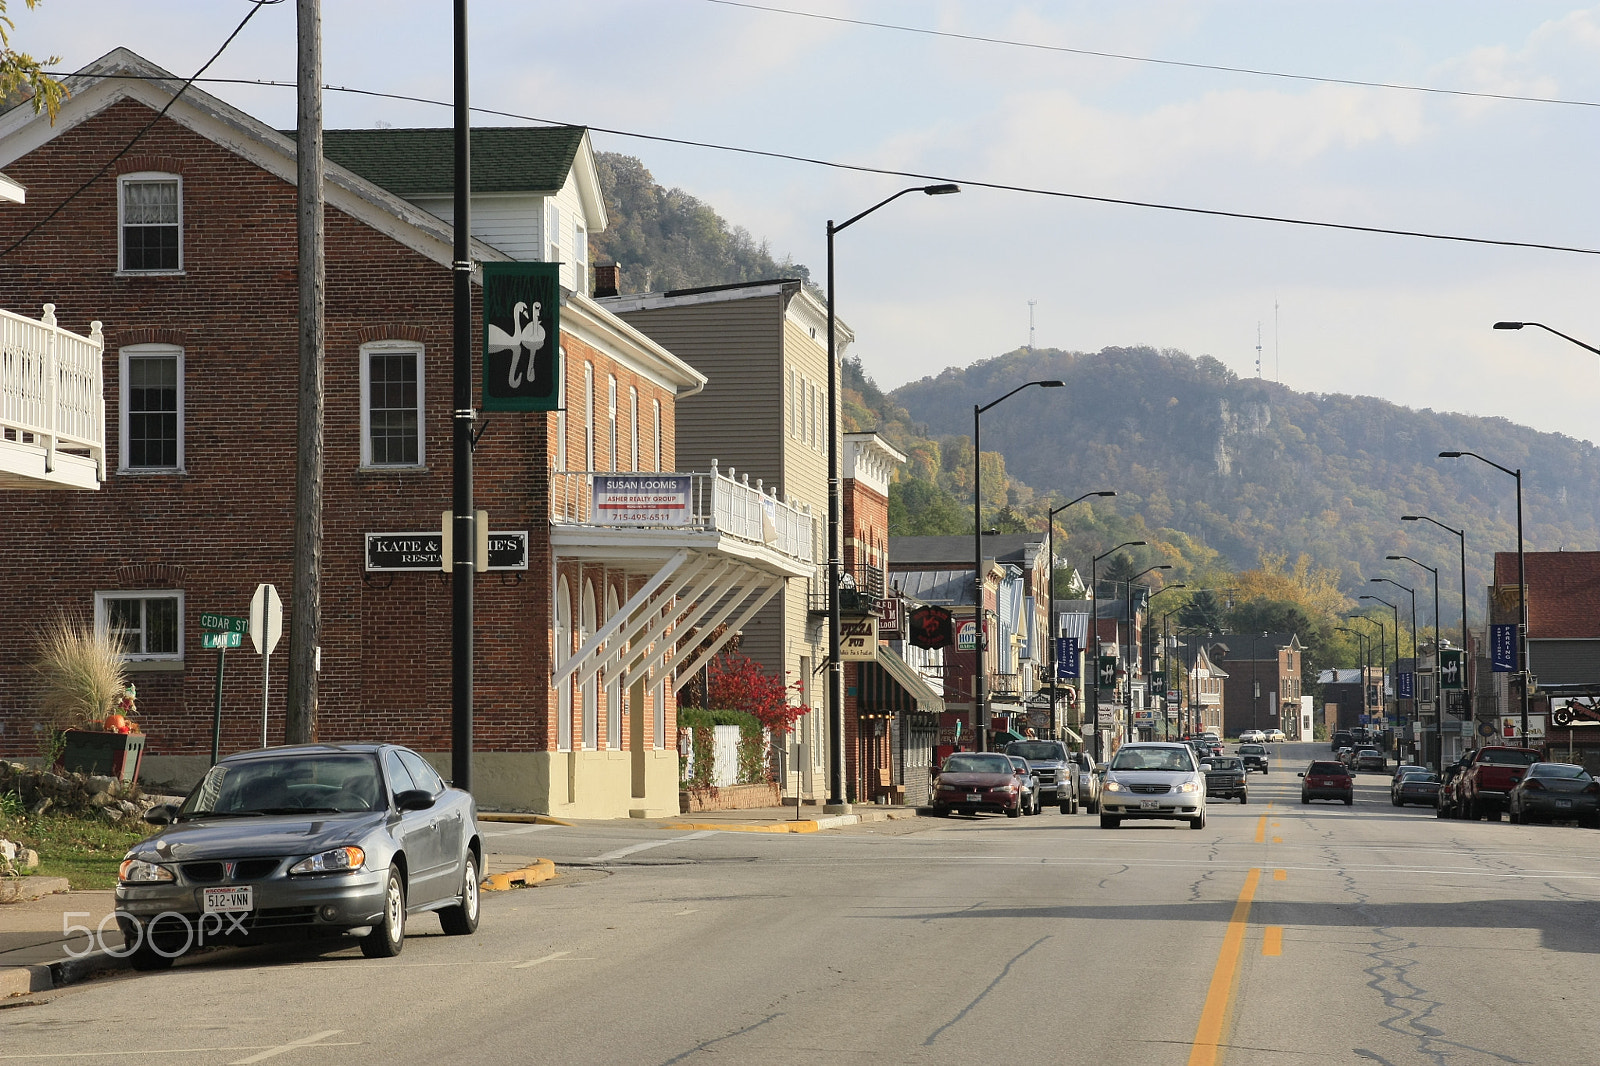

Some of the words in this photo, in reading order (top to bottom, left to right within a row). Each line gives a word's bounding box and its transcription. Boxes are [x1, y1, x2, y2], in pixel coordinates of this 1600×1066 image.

[606, 481, 638, 489] SUSAN
[640, 481, 677, 489] LOOMIS
[376, 541, 421, 552] KATE
[425, 541, 438, 552] &
[880, 610, 896, 619] AM
[201, 615, 229, 629] CEDAR
[235, 620, 246, 631] ST
[840, 623, 872, 636] PIZZA
[203, 635, 209, 645] N
[213, 634, 228, 646] MAIN
[232, 634, 240, 645] ST
[848, 638, 865, 647] PUB
[208, 893, 248, 907] 512-VNN
